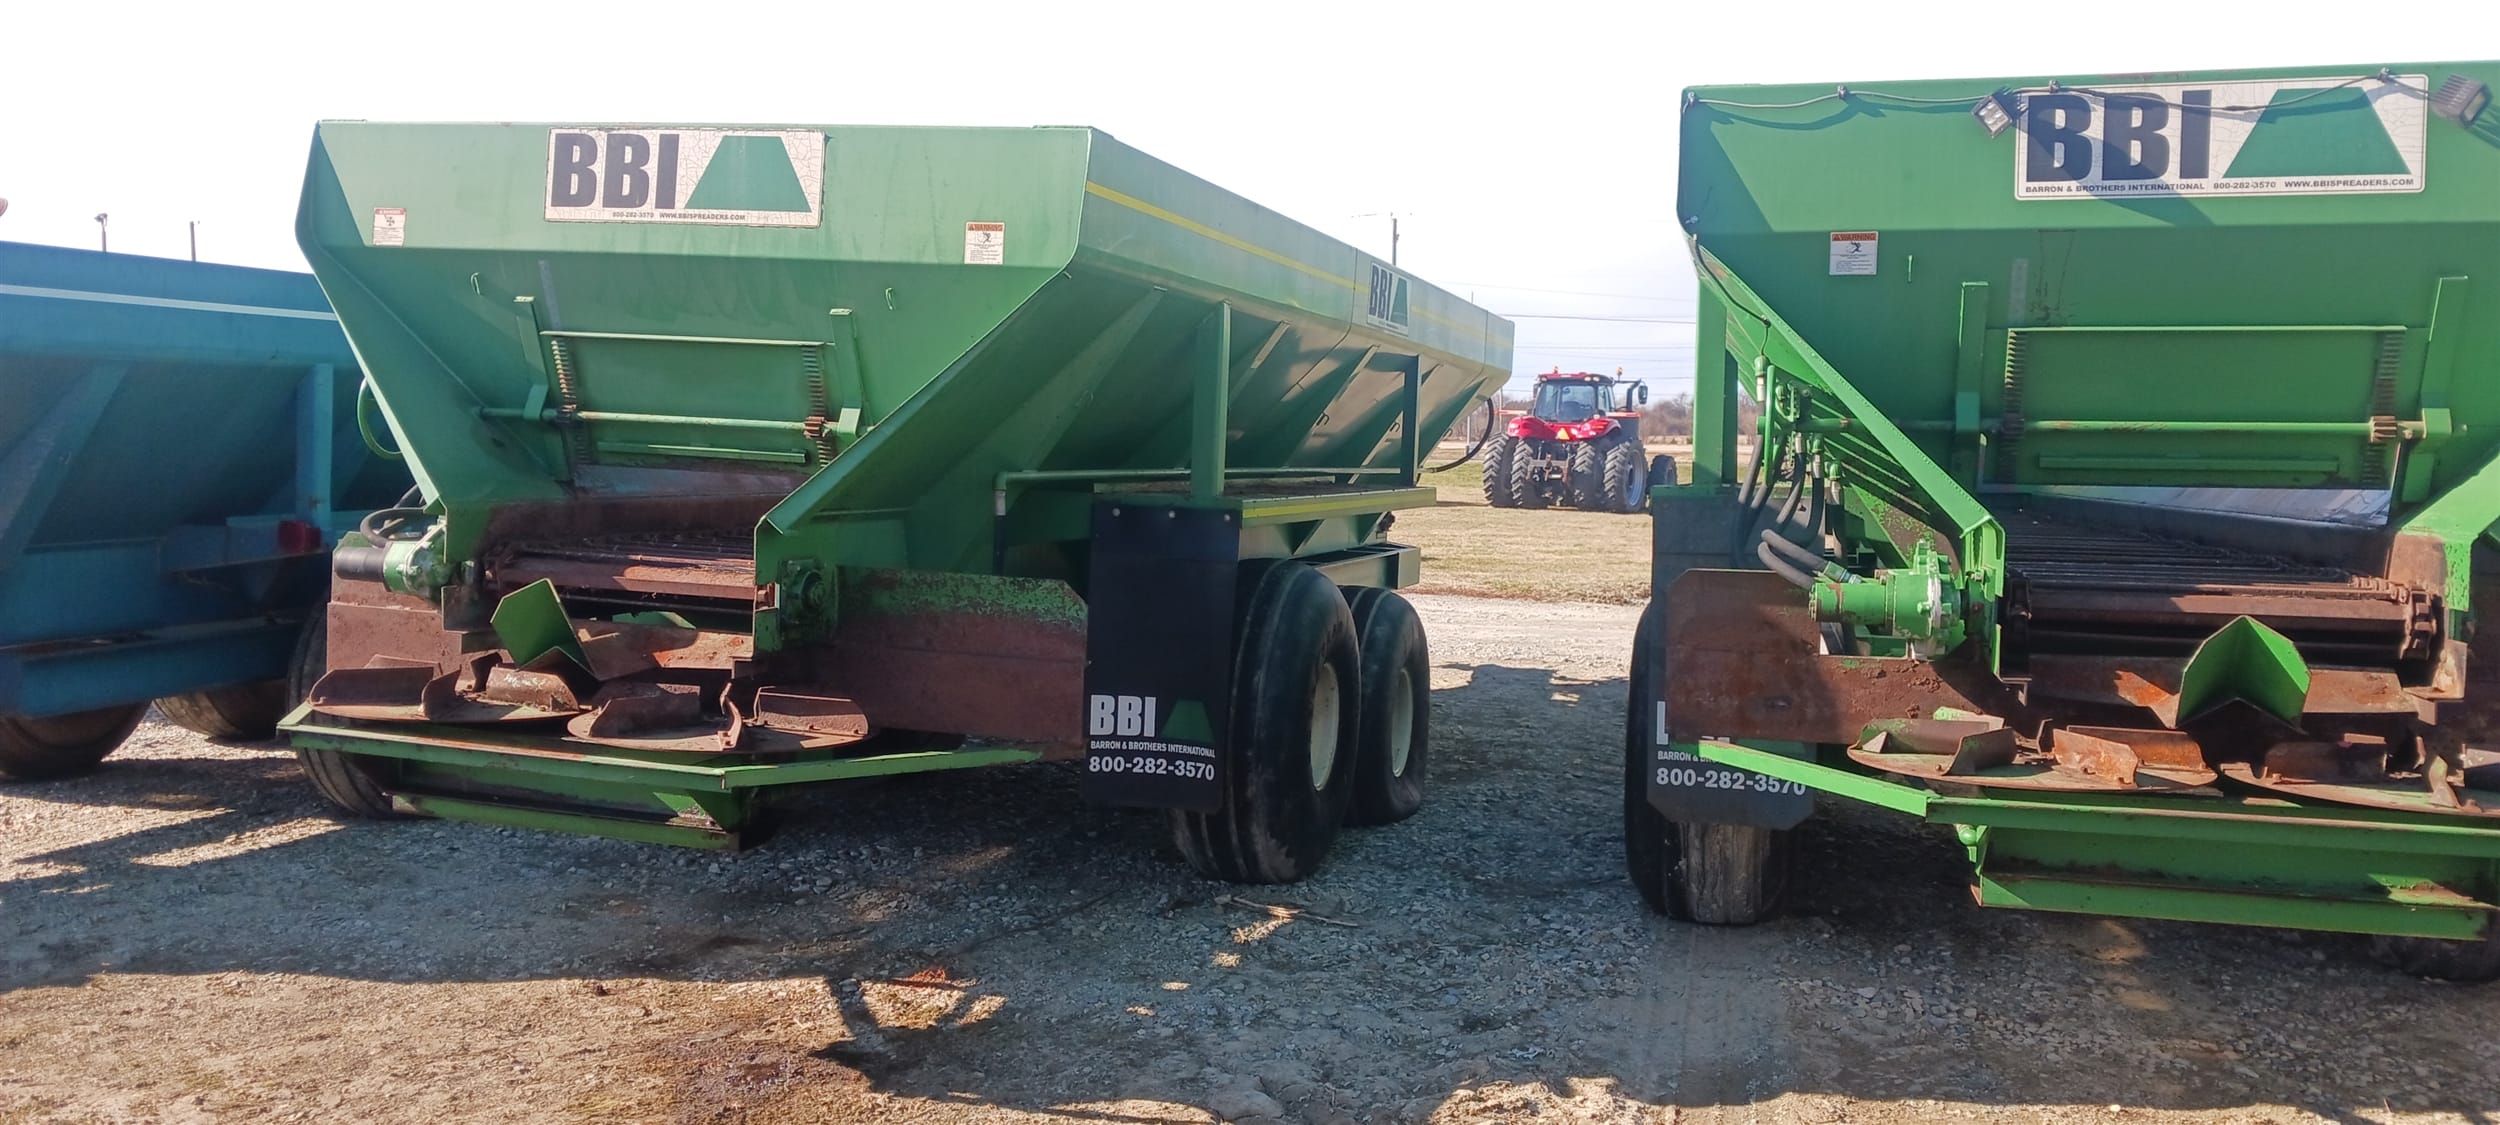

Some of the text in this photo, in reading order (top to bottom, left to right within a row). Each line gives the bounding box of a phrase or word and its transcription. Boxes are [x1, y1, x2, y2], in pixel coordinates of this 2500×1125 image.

[2026, 89, 2212, 182] BBI
[551, 133, 680, 209] BBI
[2025, 185, 2063, 193] BARRON
[2128, 183, 2205, 191] INTERNATIONAL
[2213, 181, 2276, 190] 800-282-3570
[2284, 178, 2415, 188] WWW.BBISPREADERS.COM
[660, 211, 746, 221] WWW.BBISPREADERS.COM
[1369, 265, 1393, 321] BBI
[1089, 695, 1157, 737] BBI
[1090, 740, 1216, 758] BARRON & BROTHERS INTERNATIONAL
[1657, 750, 1691, 761] BARRON
[1089, 756, 1215, 780] 800-282-3570
